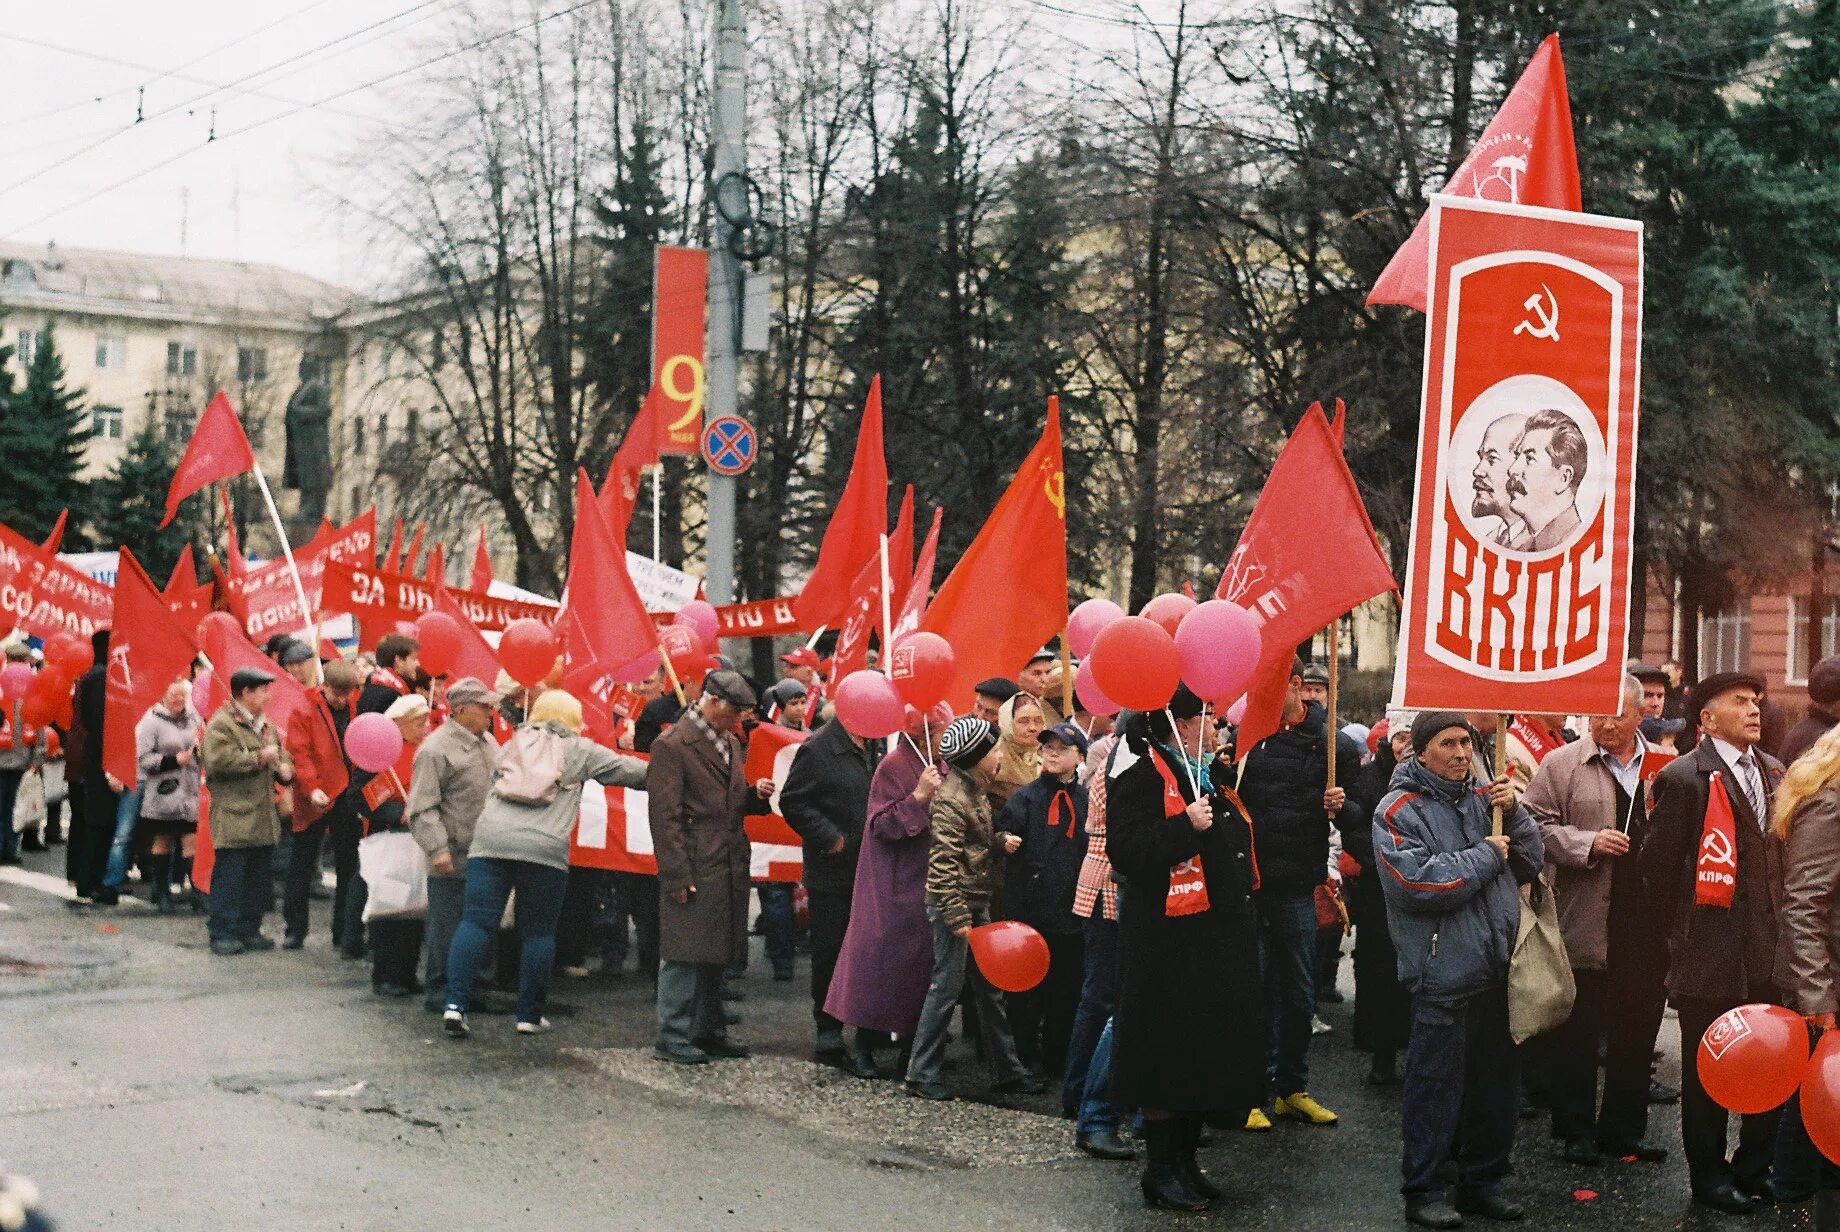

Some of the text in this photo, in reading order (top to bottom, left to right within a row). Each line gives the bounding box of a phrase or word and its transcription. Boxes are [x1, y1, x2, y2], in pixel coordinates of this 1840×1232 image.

[661, 354, 704, 430] 9
[351, 571, 385, 608] ЗА
[1436, 478, 1606, 671] ВКПБ
[1698, 870, 1734, 886] КПРФ
